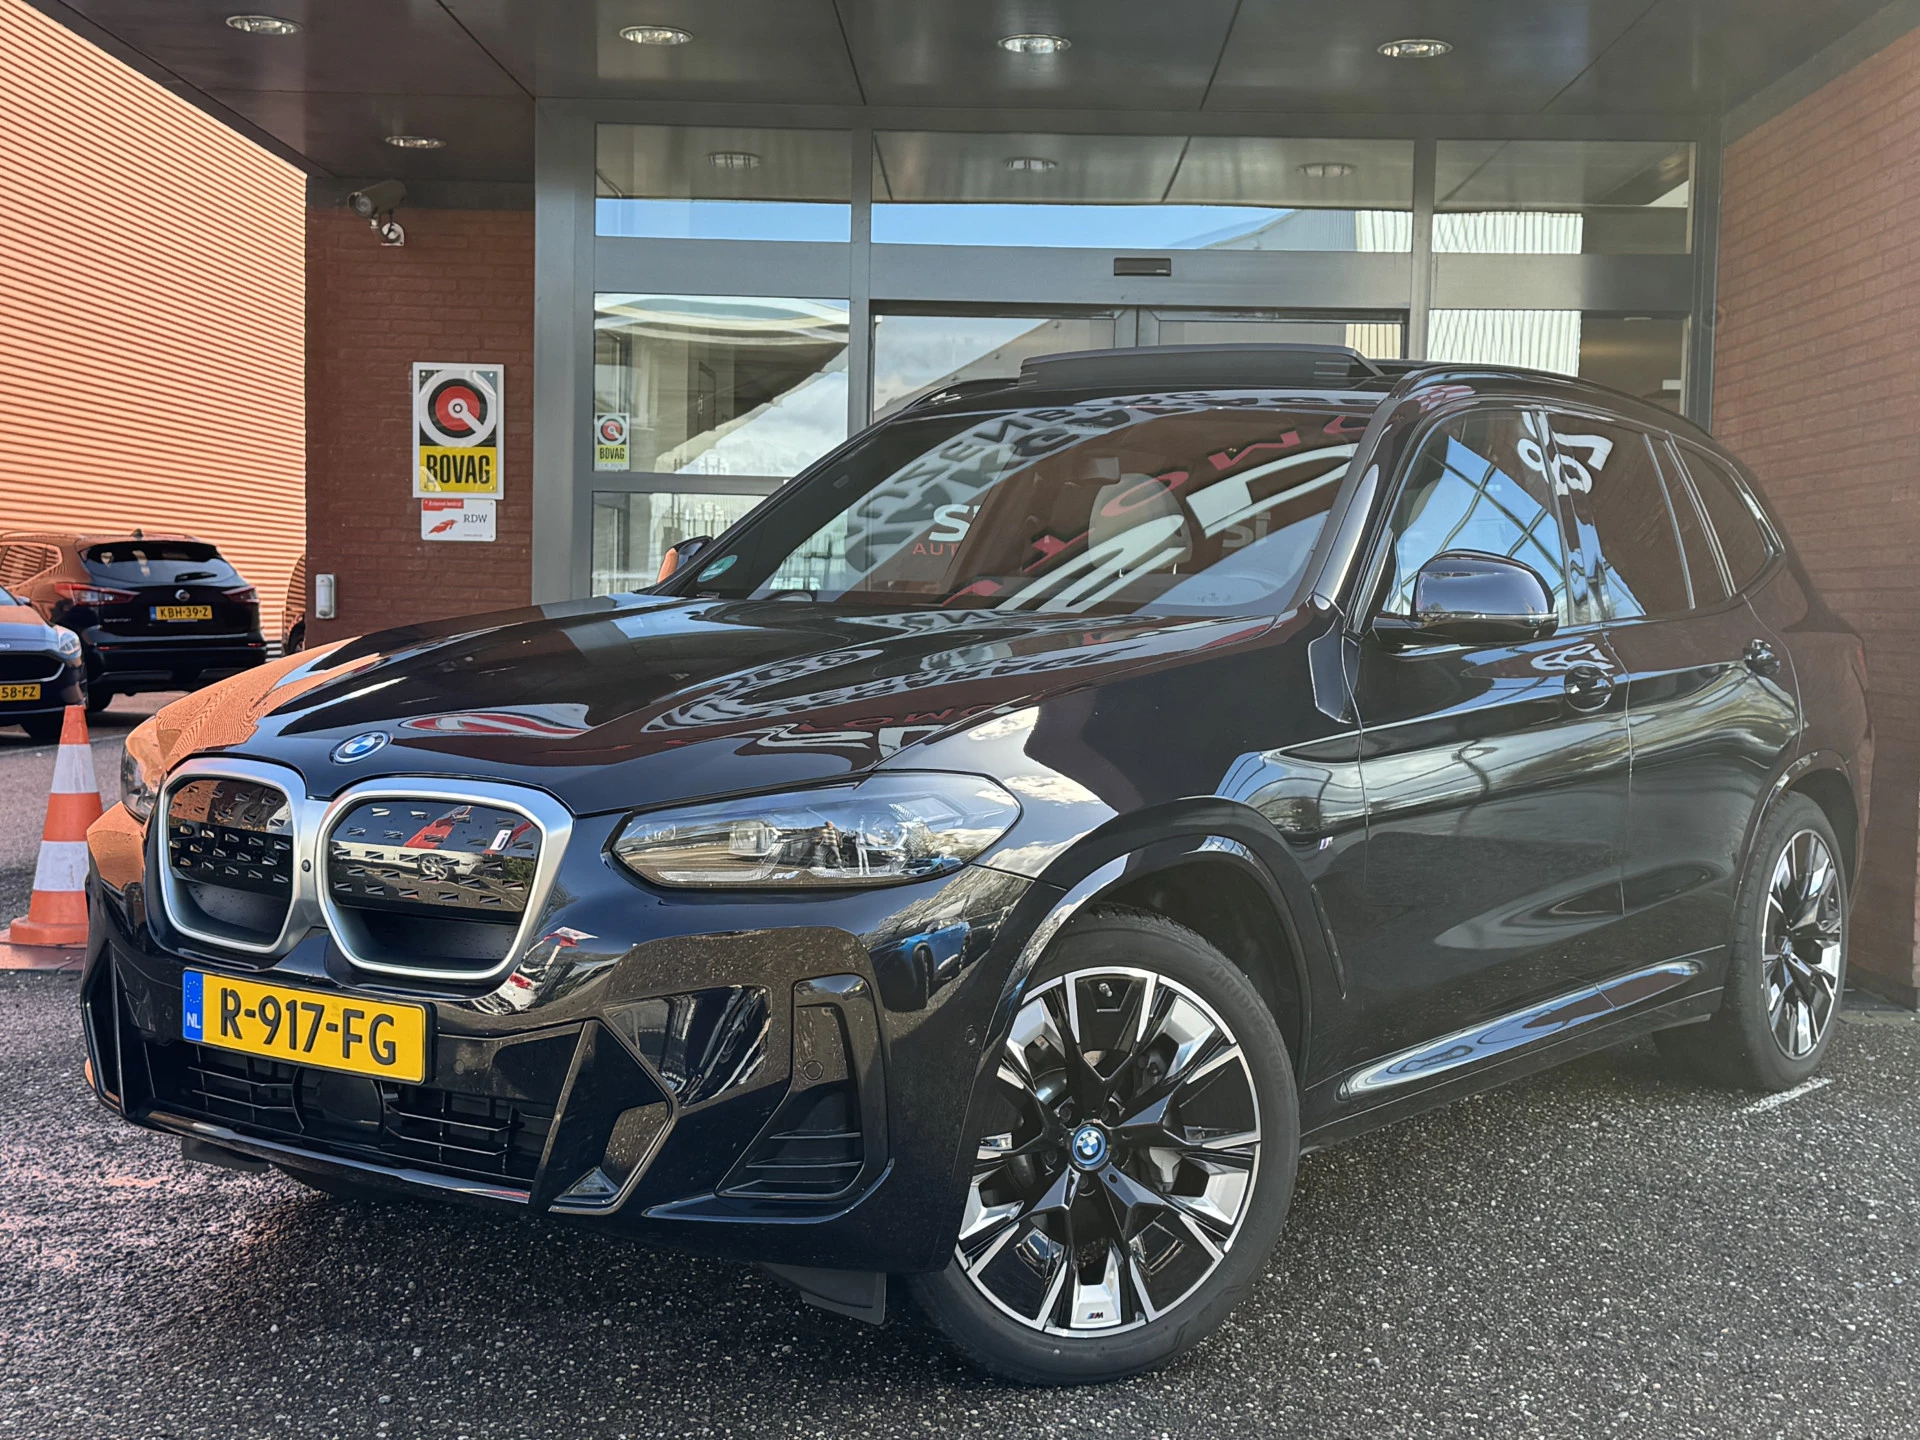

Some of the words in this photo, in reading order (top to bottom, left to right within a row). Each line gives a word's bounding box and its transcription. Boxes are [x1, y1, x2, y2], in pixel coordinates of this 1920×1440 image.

[600, 447, 625, 460] BOVAG
[426, 454, 491, 484] BOVAG
[463, 513, 488, 523] RDW
[160, 607, 209, 618] KBH-39-Z
[186, 1012, 201, 1030] NL
[220, 987, 396, 1066] R-917-FG
